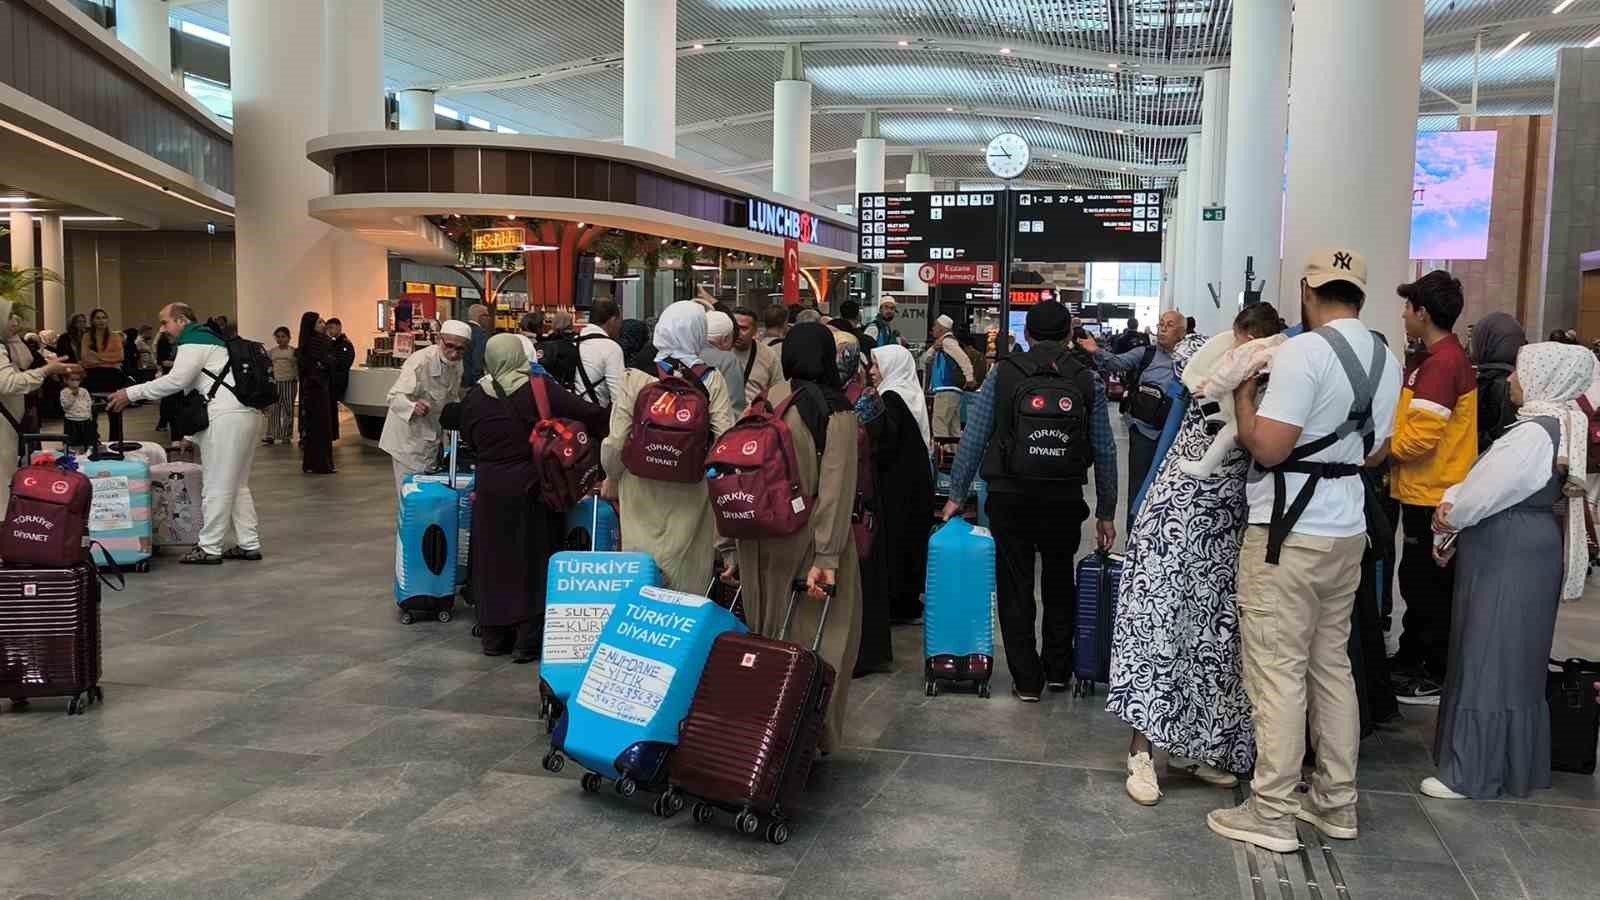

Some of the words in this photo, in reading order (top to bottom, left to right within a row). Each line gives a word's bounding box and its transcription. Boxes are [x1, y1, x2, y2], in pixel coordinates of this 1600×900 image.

[748, 199, 818, 244] LUNCHBOX
[1332, 251, 1352, 270] NY
[940, 272, 976, 281] Pharmacy
[902, 308, 925, 319] ATM
[555, 558, 640, 575] TÜRKİYE
[557, 577, 633, 592] DİYANET
[627, 603, 697, 633] TÜRKİYE
[617, 621, 681, 649] DİYANET
